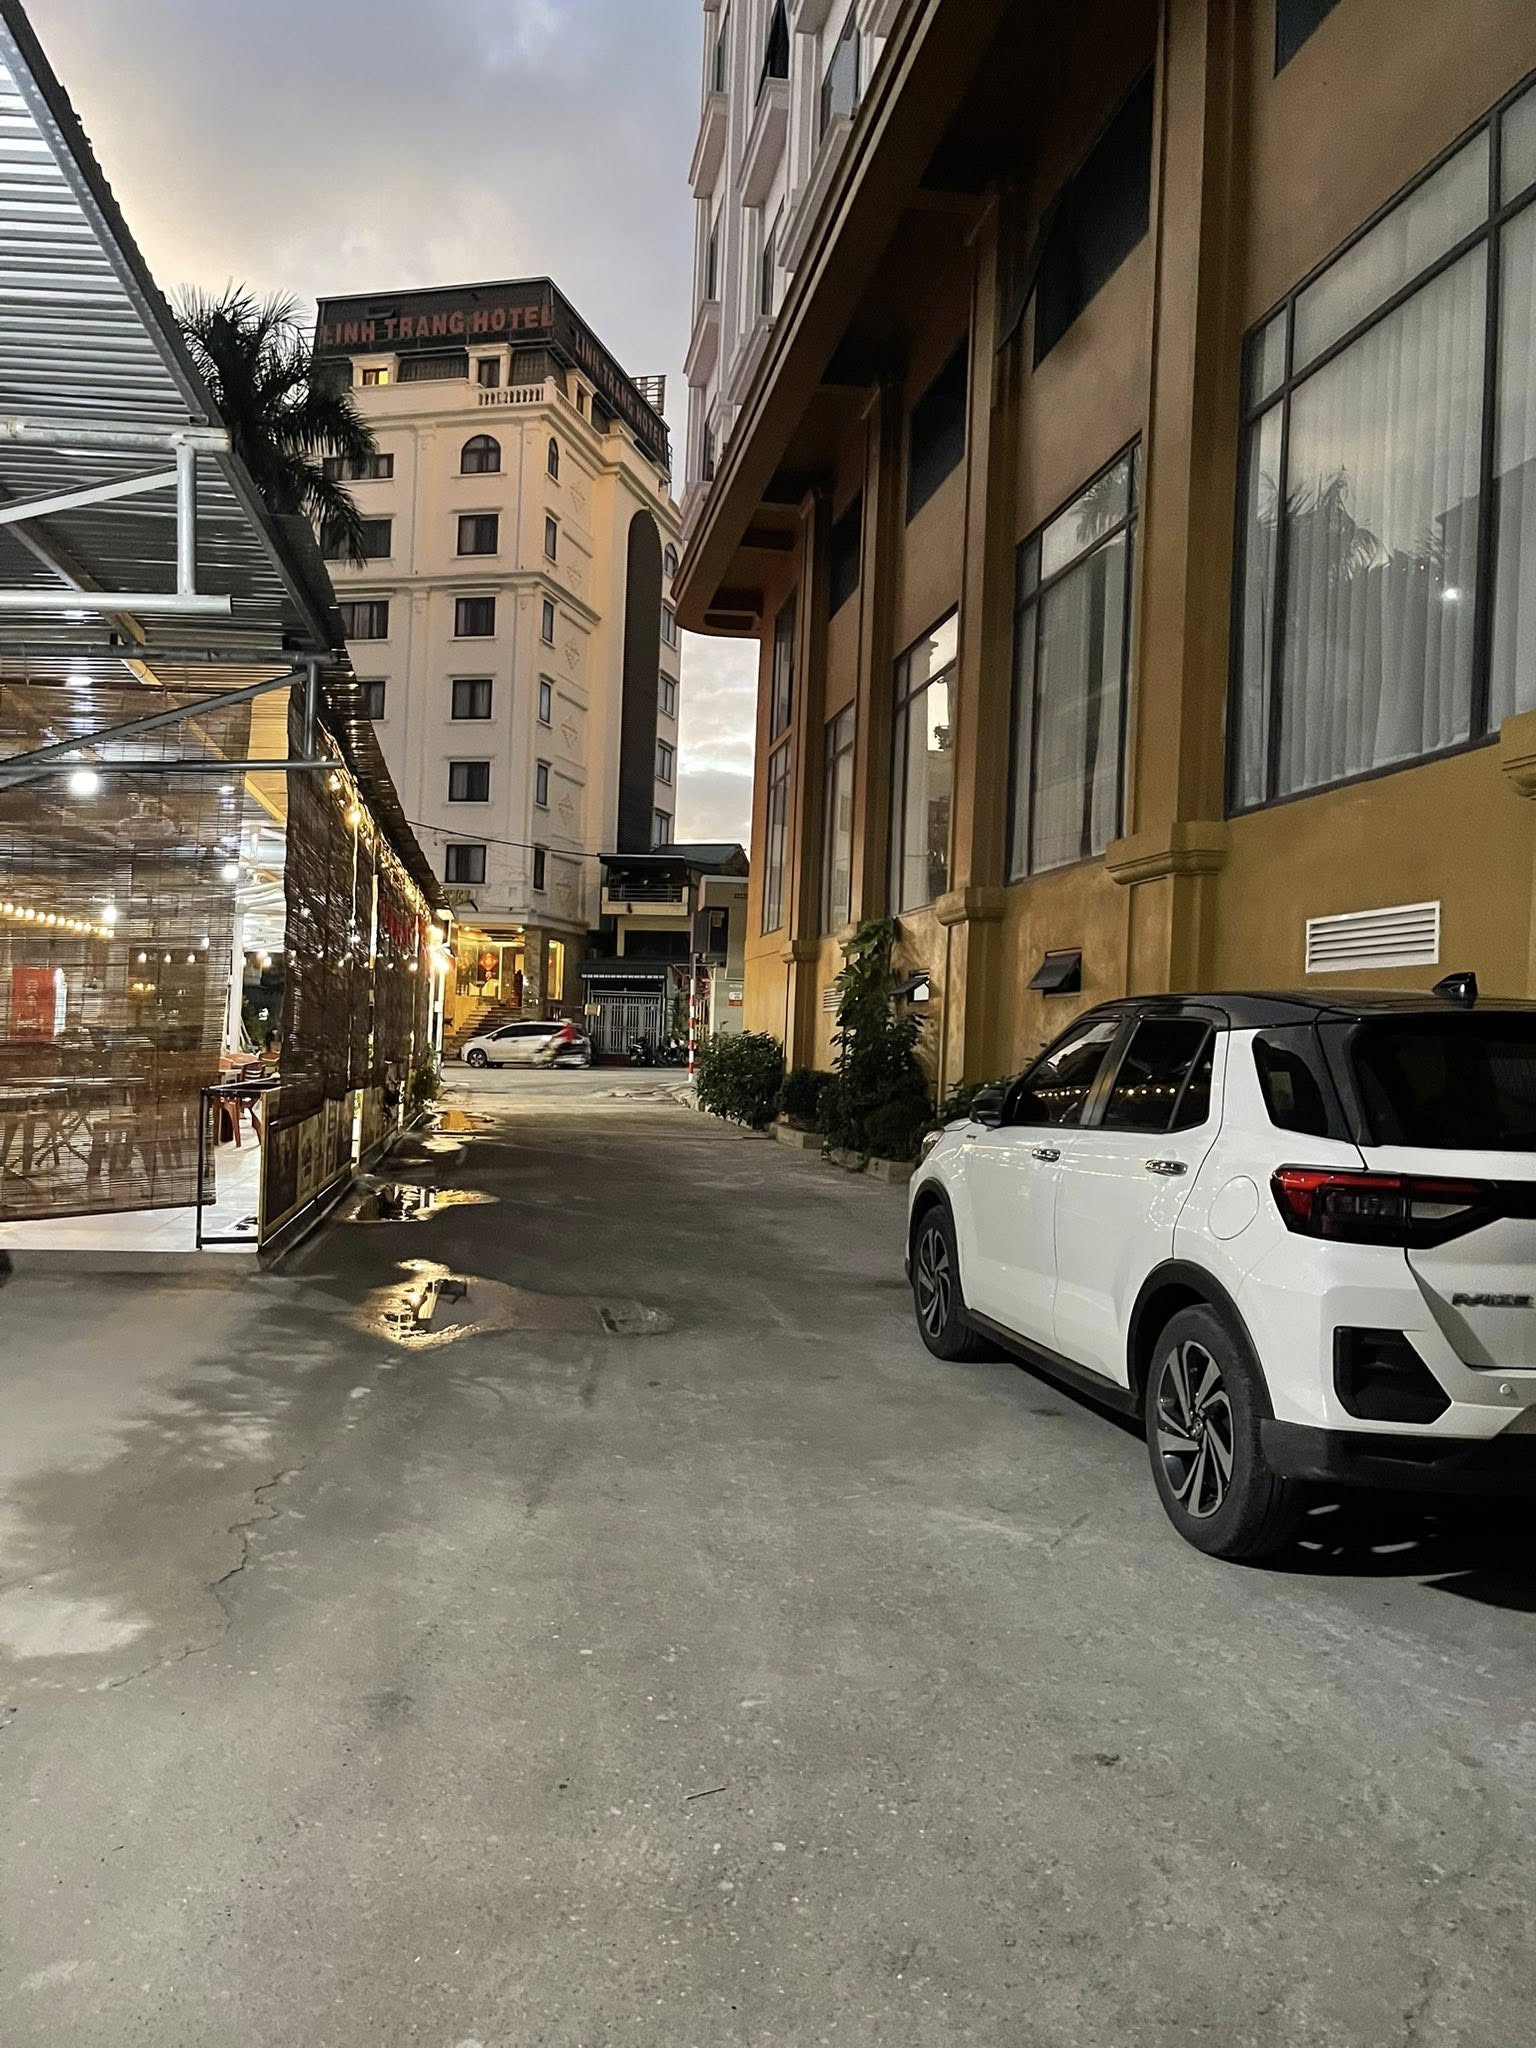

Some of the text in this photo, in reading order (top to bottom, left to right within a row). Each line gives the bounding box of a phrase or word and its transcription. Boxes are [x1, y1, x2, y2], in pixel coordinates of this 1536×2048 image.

[320, 304, 555, 346] LINH TRANG HOTEL
